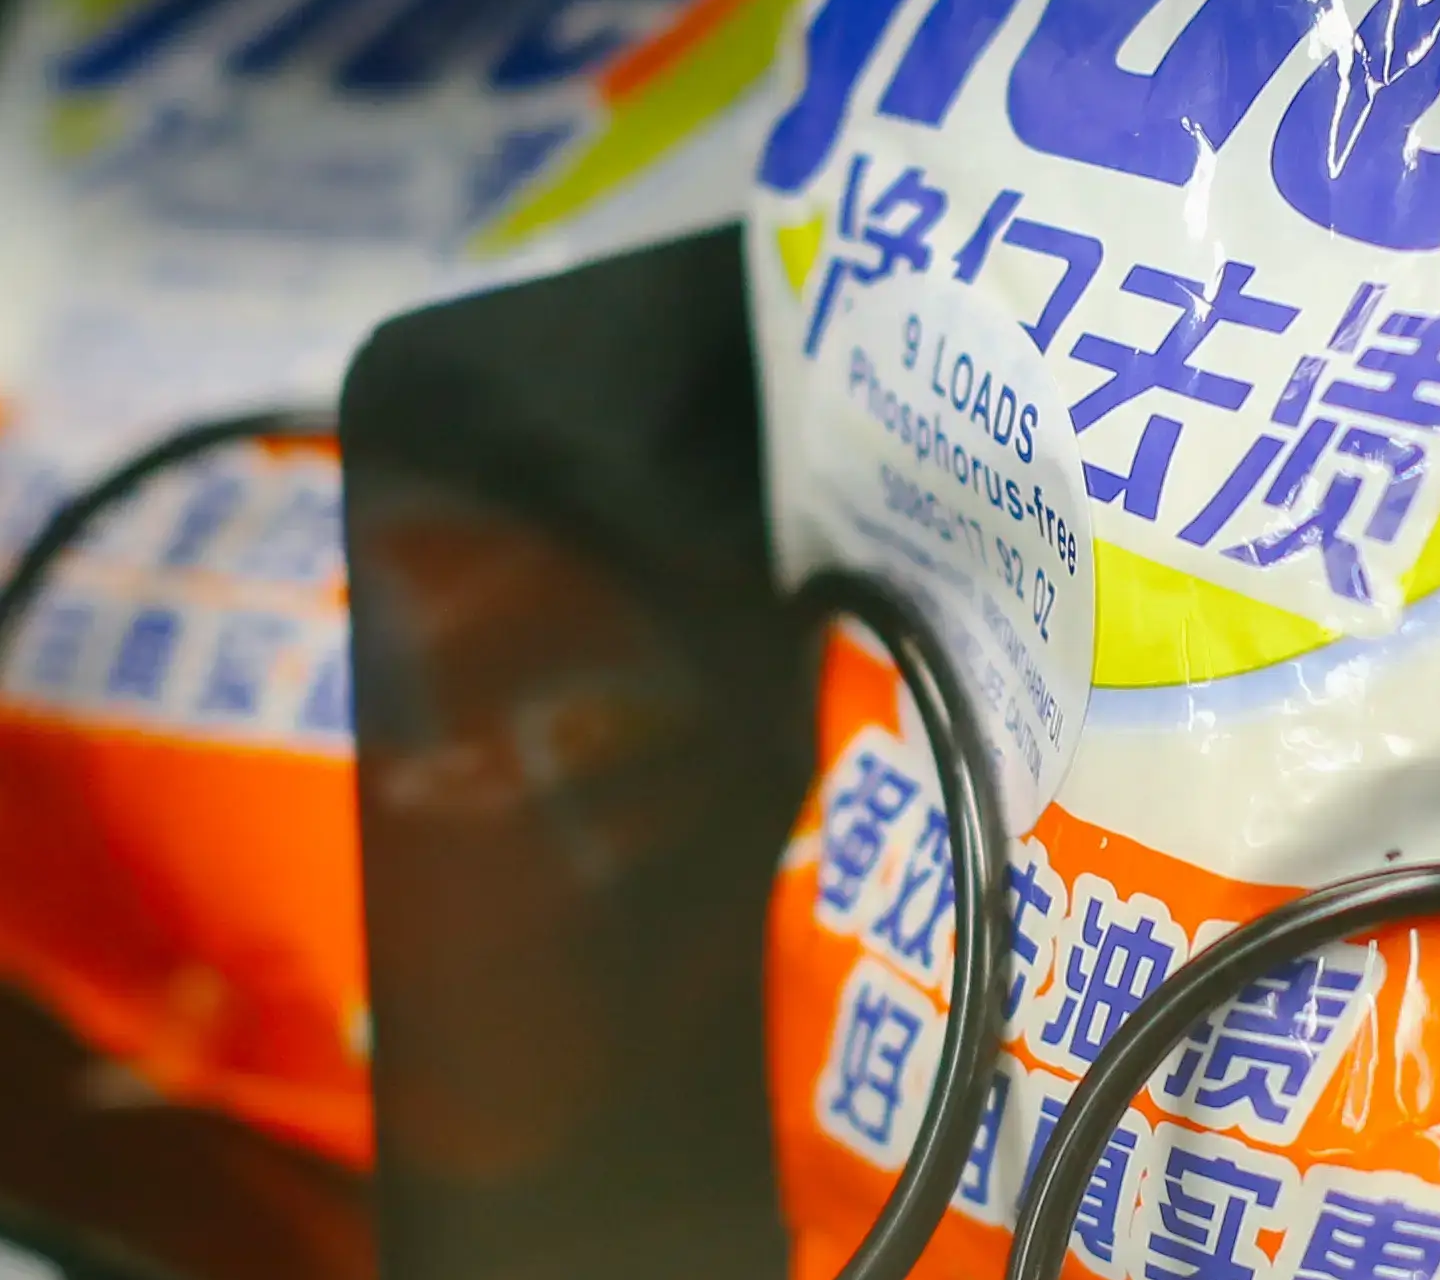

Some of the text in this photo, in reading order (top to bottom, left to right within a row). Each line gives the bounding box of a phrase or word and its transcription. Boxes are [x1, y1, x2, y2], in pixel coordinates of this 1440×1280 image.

[848, 342, 1078, 577] Phosphorus-free
[900, 312, 1040, 465] 9 LOADS
